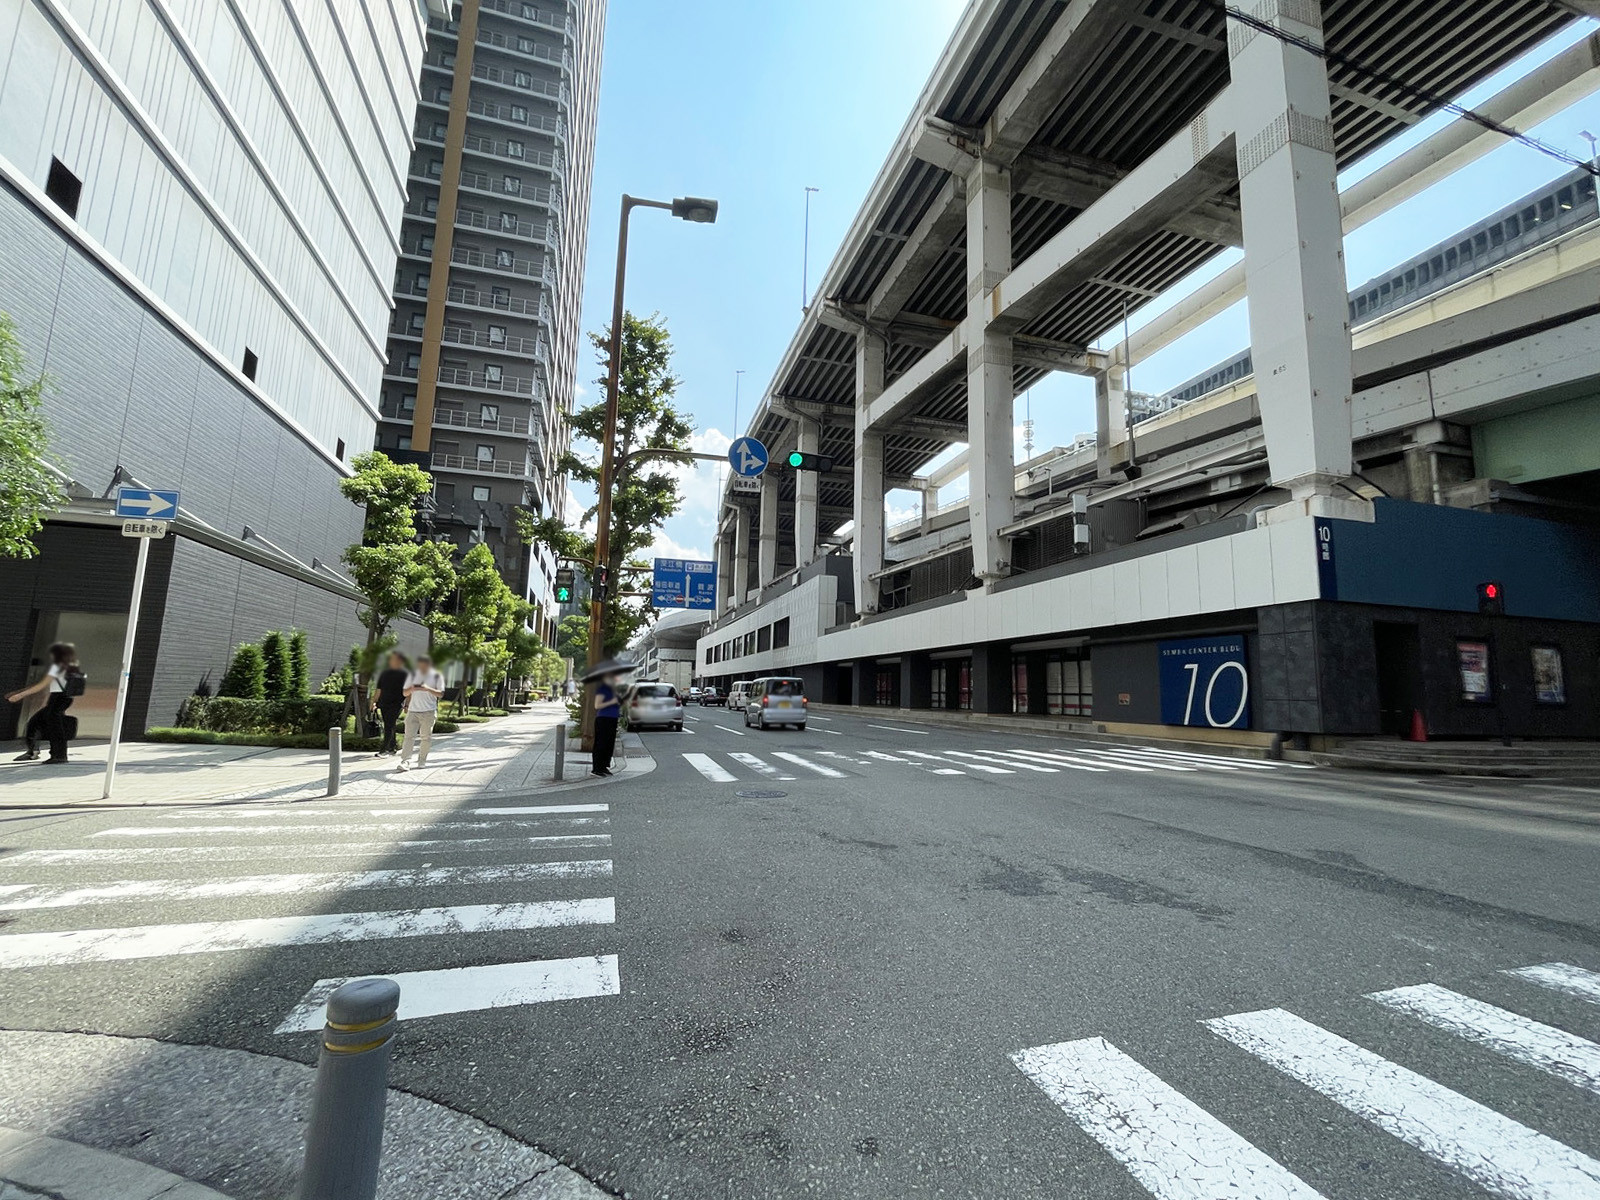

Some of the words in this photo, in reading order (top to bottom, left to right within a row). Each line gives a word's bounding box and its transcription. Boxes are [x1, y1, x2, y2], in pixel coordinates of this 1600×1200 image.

[124, 523, 163, 534] 自転車を除く
[1188, 646, 1217, 655] CENTER
[1183, 661, 1248, 728] 10
